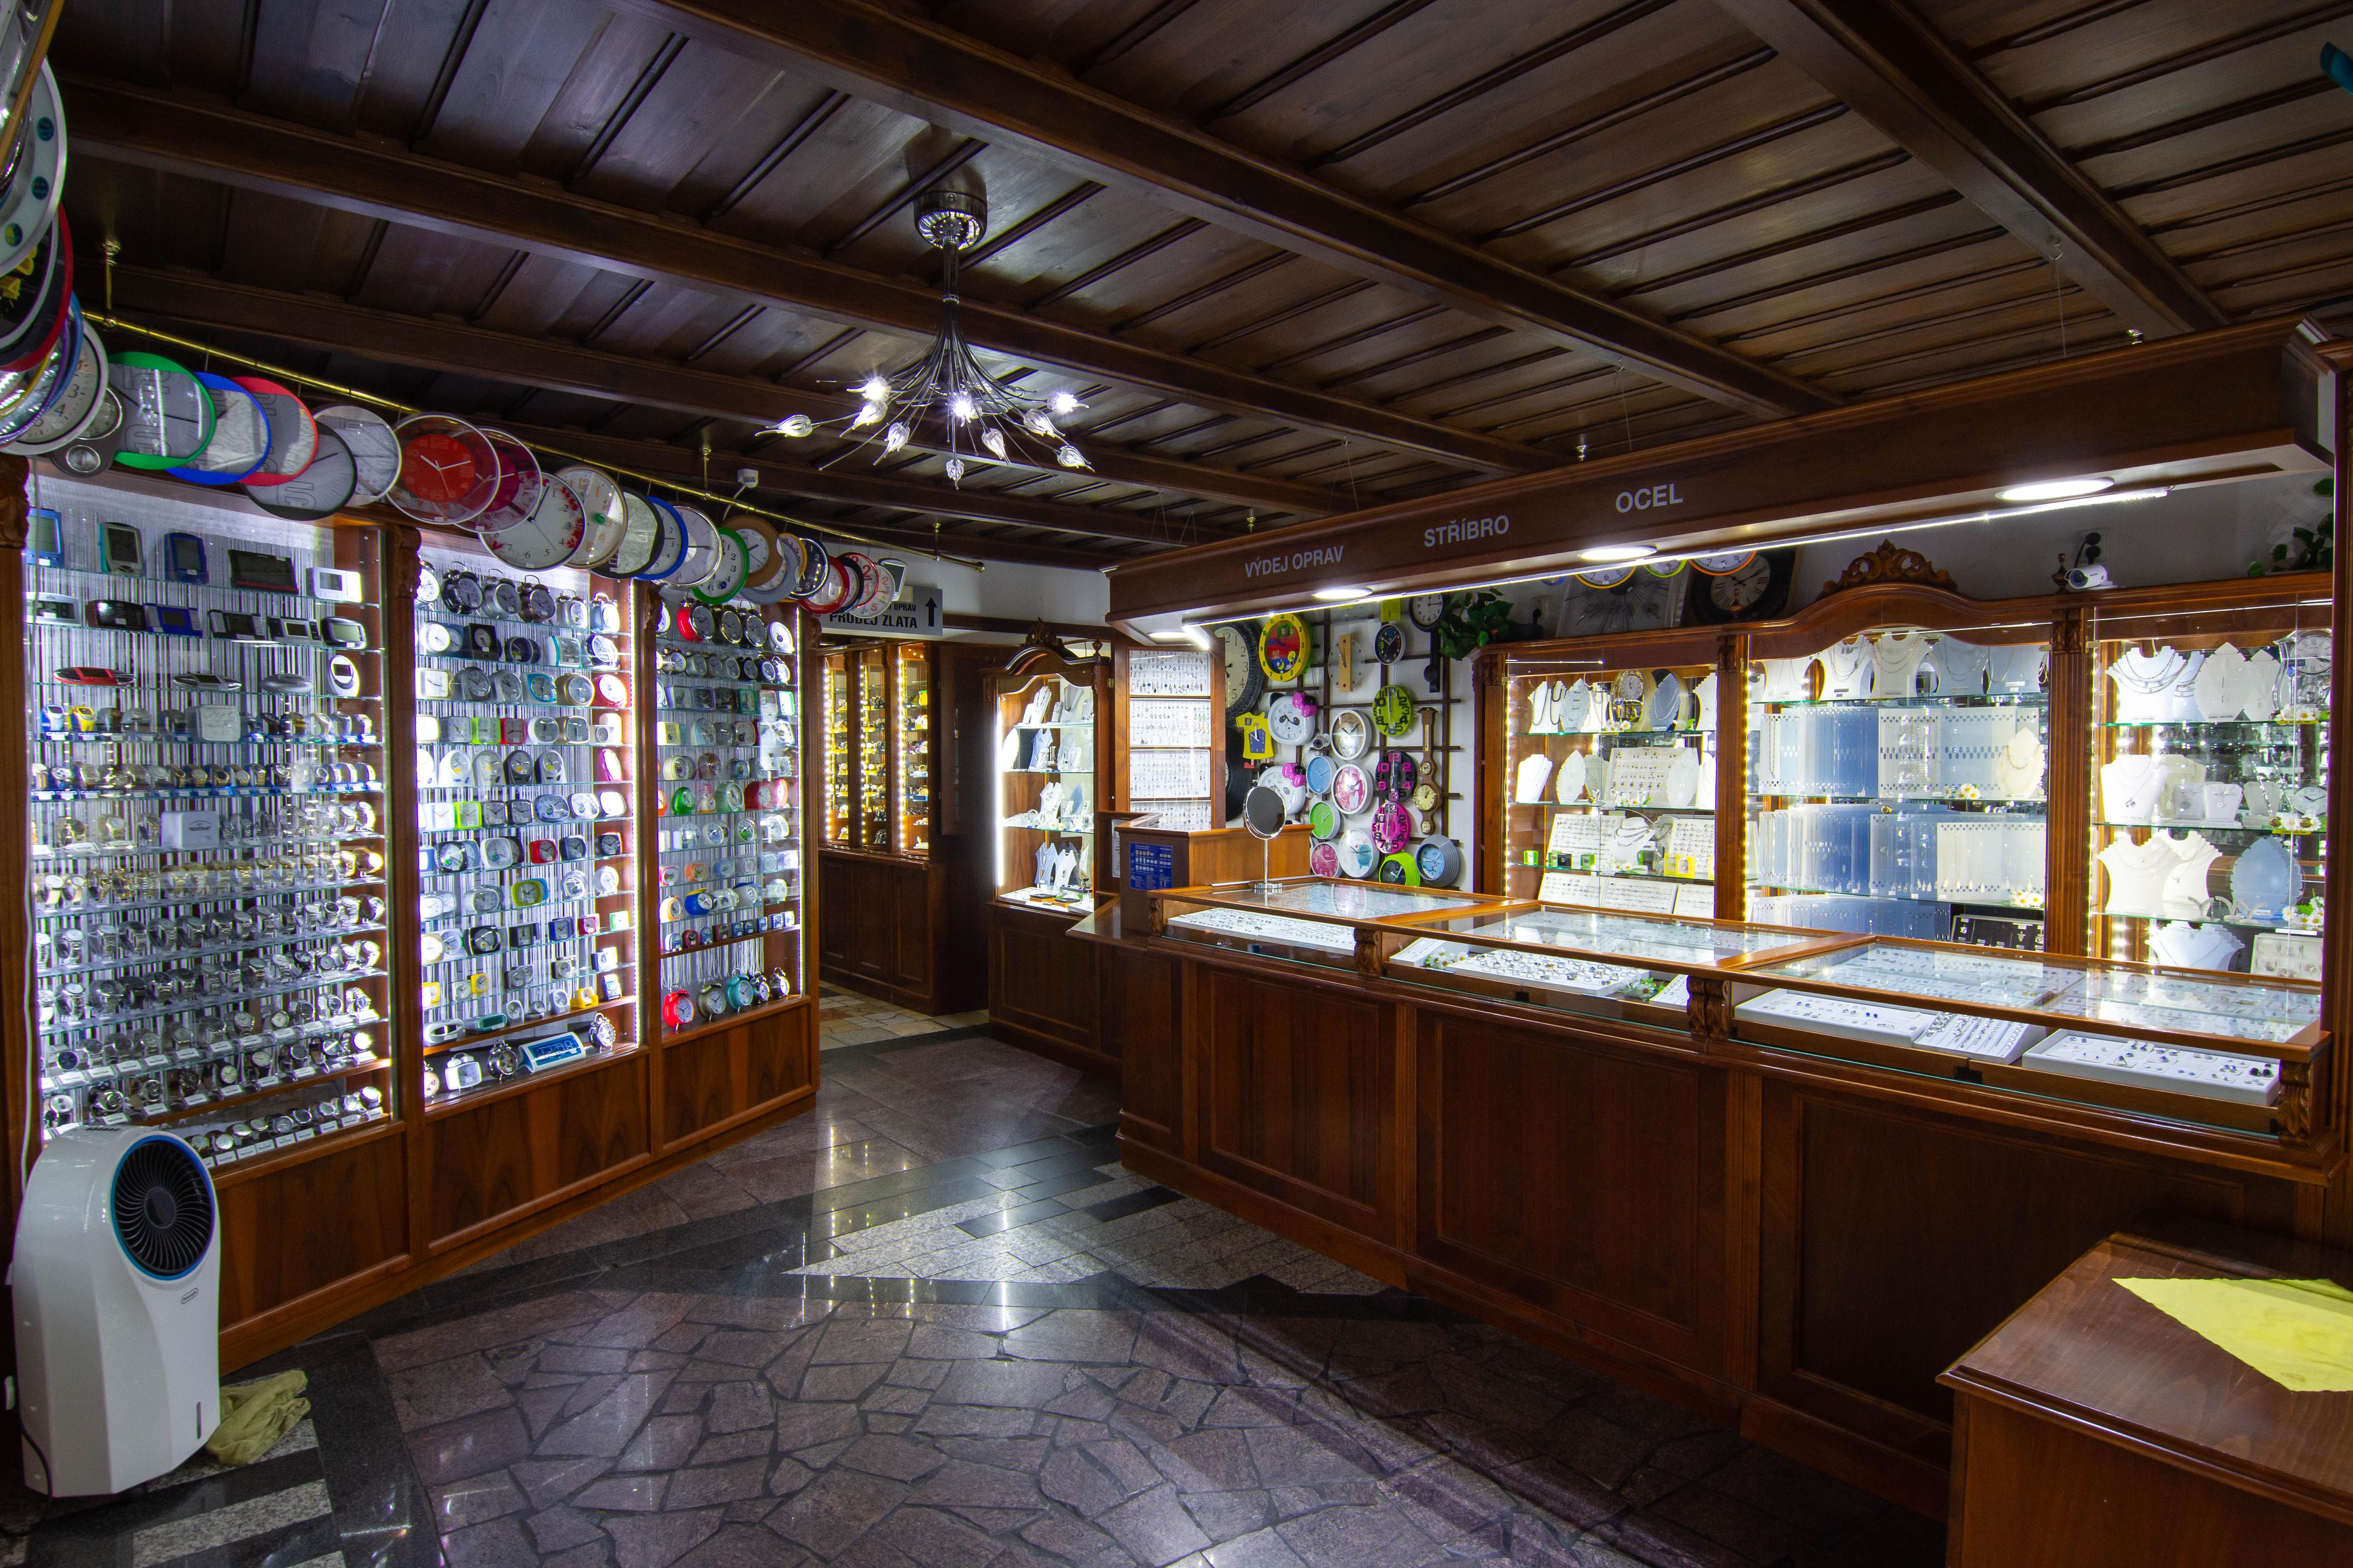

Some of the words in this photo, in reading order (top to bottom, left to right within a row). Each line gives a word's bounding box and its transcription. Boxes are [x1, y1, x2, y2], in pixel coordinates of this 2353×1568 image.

[68, 384, 79, 398] 3
[552, 489, 556, 498] 1
[1616, 483, 1684, 513] OCEL
[563, 503, 569, 512] 2
[566, 522, 572, 531] 3
[1424, 515, 1509, 547] STŘÍBRO
[558, 538, 565, 546] 4
[507, 543, 513, 552] 7
[525, 551, 531, 559] 6
[1245, 556, 1288, 578] VÝDEJ
[1292, 545, 1344, 569] OPRAV
[863, 564, 871, 578] 2
[882, 576, 889, 585] 2
[708, 584, 714, 592] 6
[871, 603, 878, 612] 5
[894, 602, 916, 612] OPRAV
[882, 615, 918, 629] ZLATA
[1235, 635, 1238, 646] 1
[1380, 641, 1384, 649] 9
[1241, 646, 1247, 657] 2
[1243, 661, 1248, 672] 3
[1239, 678, 1245, 688] 4
[1232, 689, 1238, 700] 5
[1399, 696, 1408, 706] 2
[1402, 706, 1410, 715] 3
[1376, 716, 1384, 725] 8
[1399, 715, 1409, 724] 4
[1377, 763, 1390, 772] 10
[1402, 762, 1412, 772] 2
[1378, 781, 1387, 791] 8
[1402, 781, 1412, 790] 4
[1385, 804, 1397, 813] 12
[1375, 814, 1386, 823] 10
[1398, 815, 1407, 824] 2
[1399, 823, 1408, 833] 3
[1397, 833, 1405, 843] 4
[1392, 839, 1399, 849] 5
